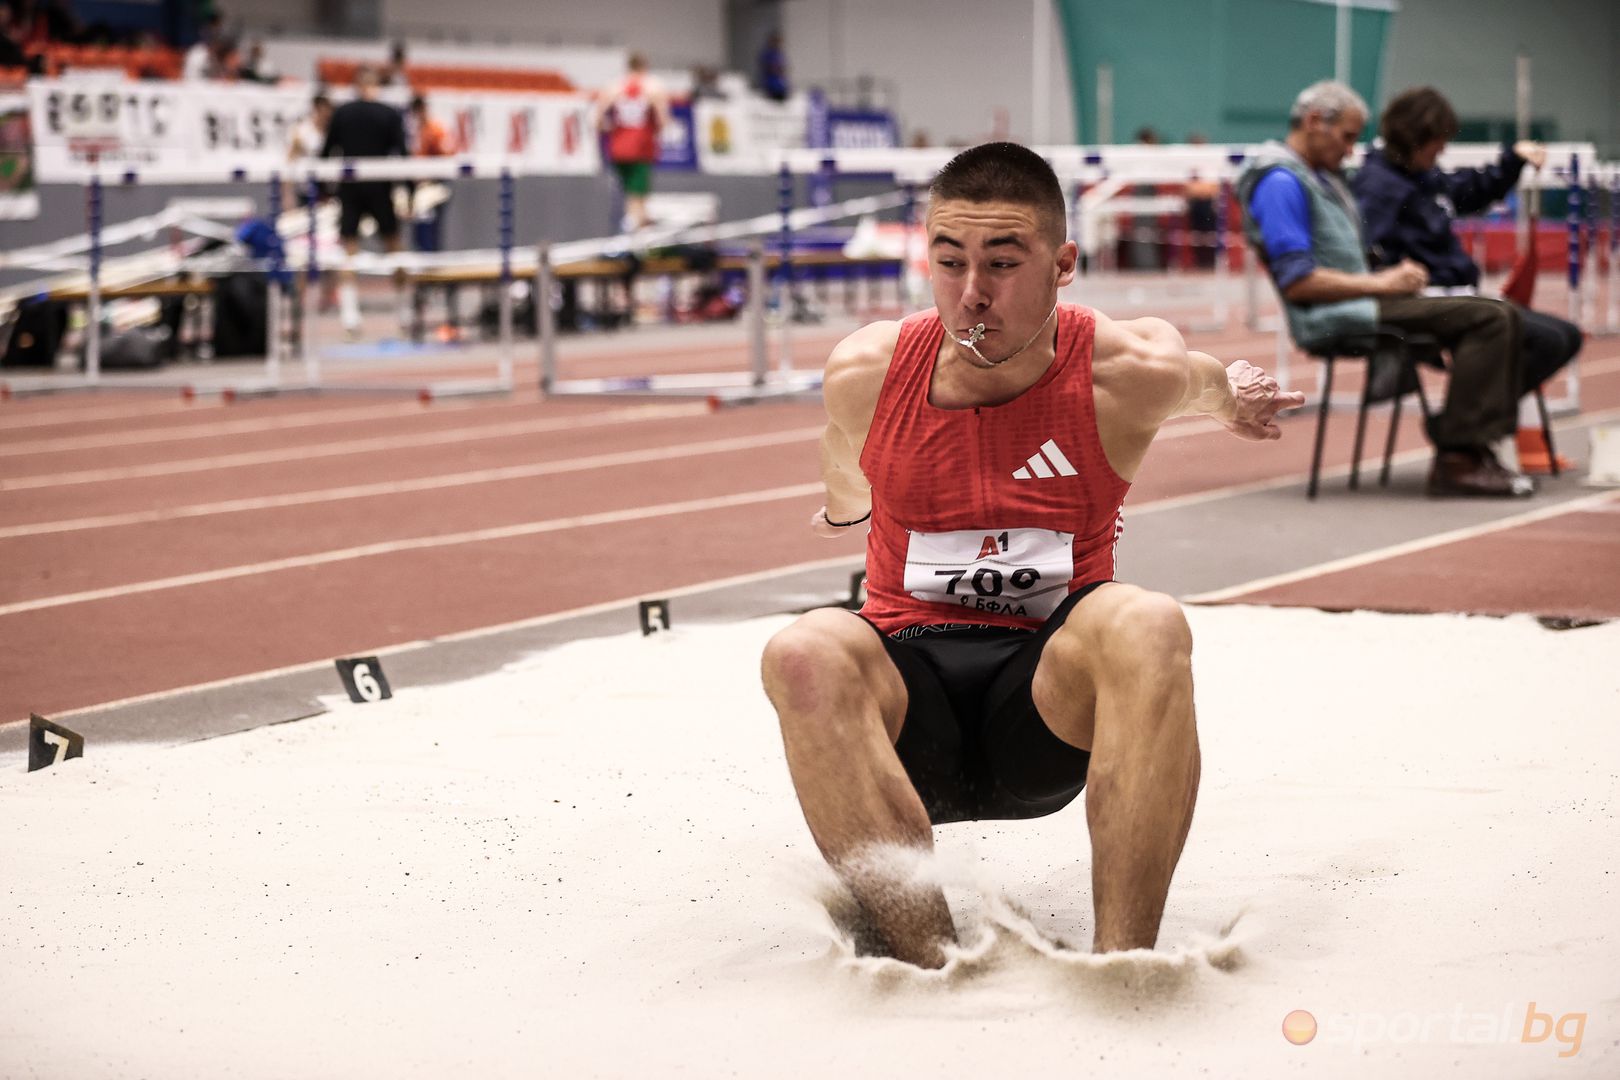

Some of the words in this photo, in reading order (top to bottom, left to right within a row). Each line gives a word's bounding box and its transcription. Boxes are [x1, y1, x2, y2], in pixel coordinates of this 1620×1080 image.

[976, 531, 1009, 560] A1
[648, 606, 666, 631] 5
[975, 599, 1028, 617] БФЛА
[352, 663, 383, 702] 6
[44, 730, 70, 766] 7
